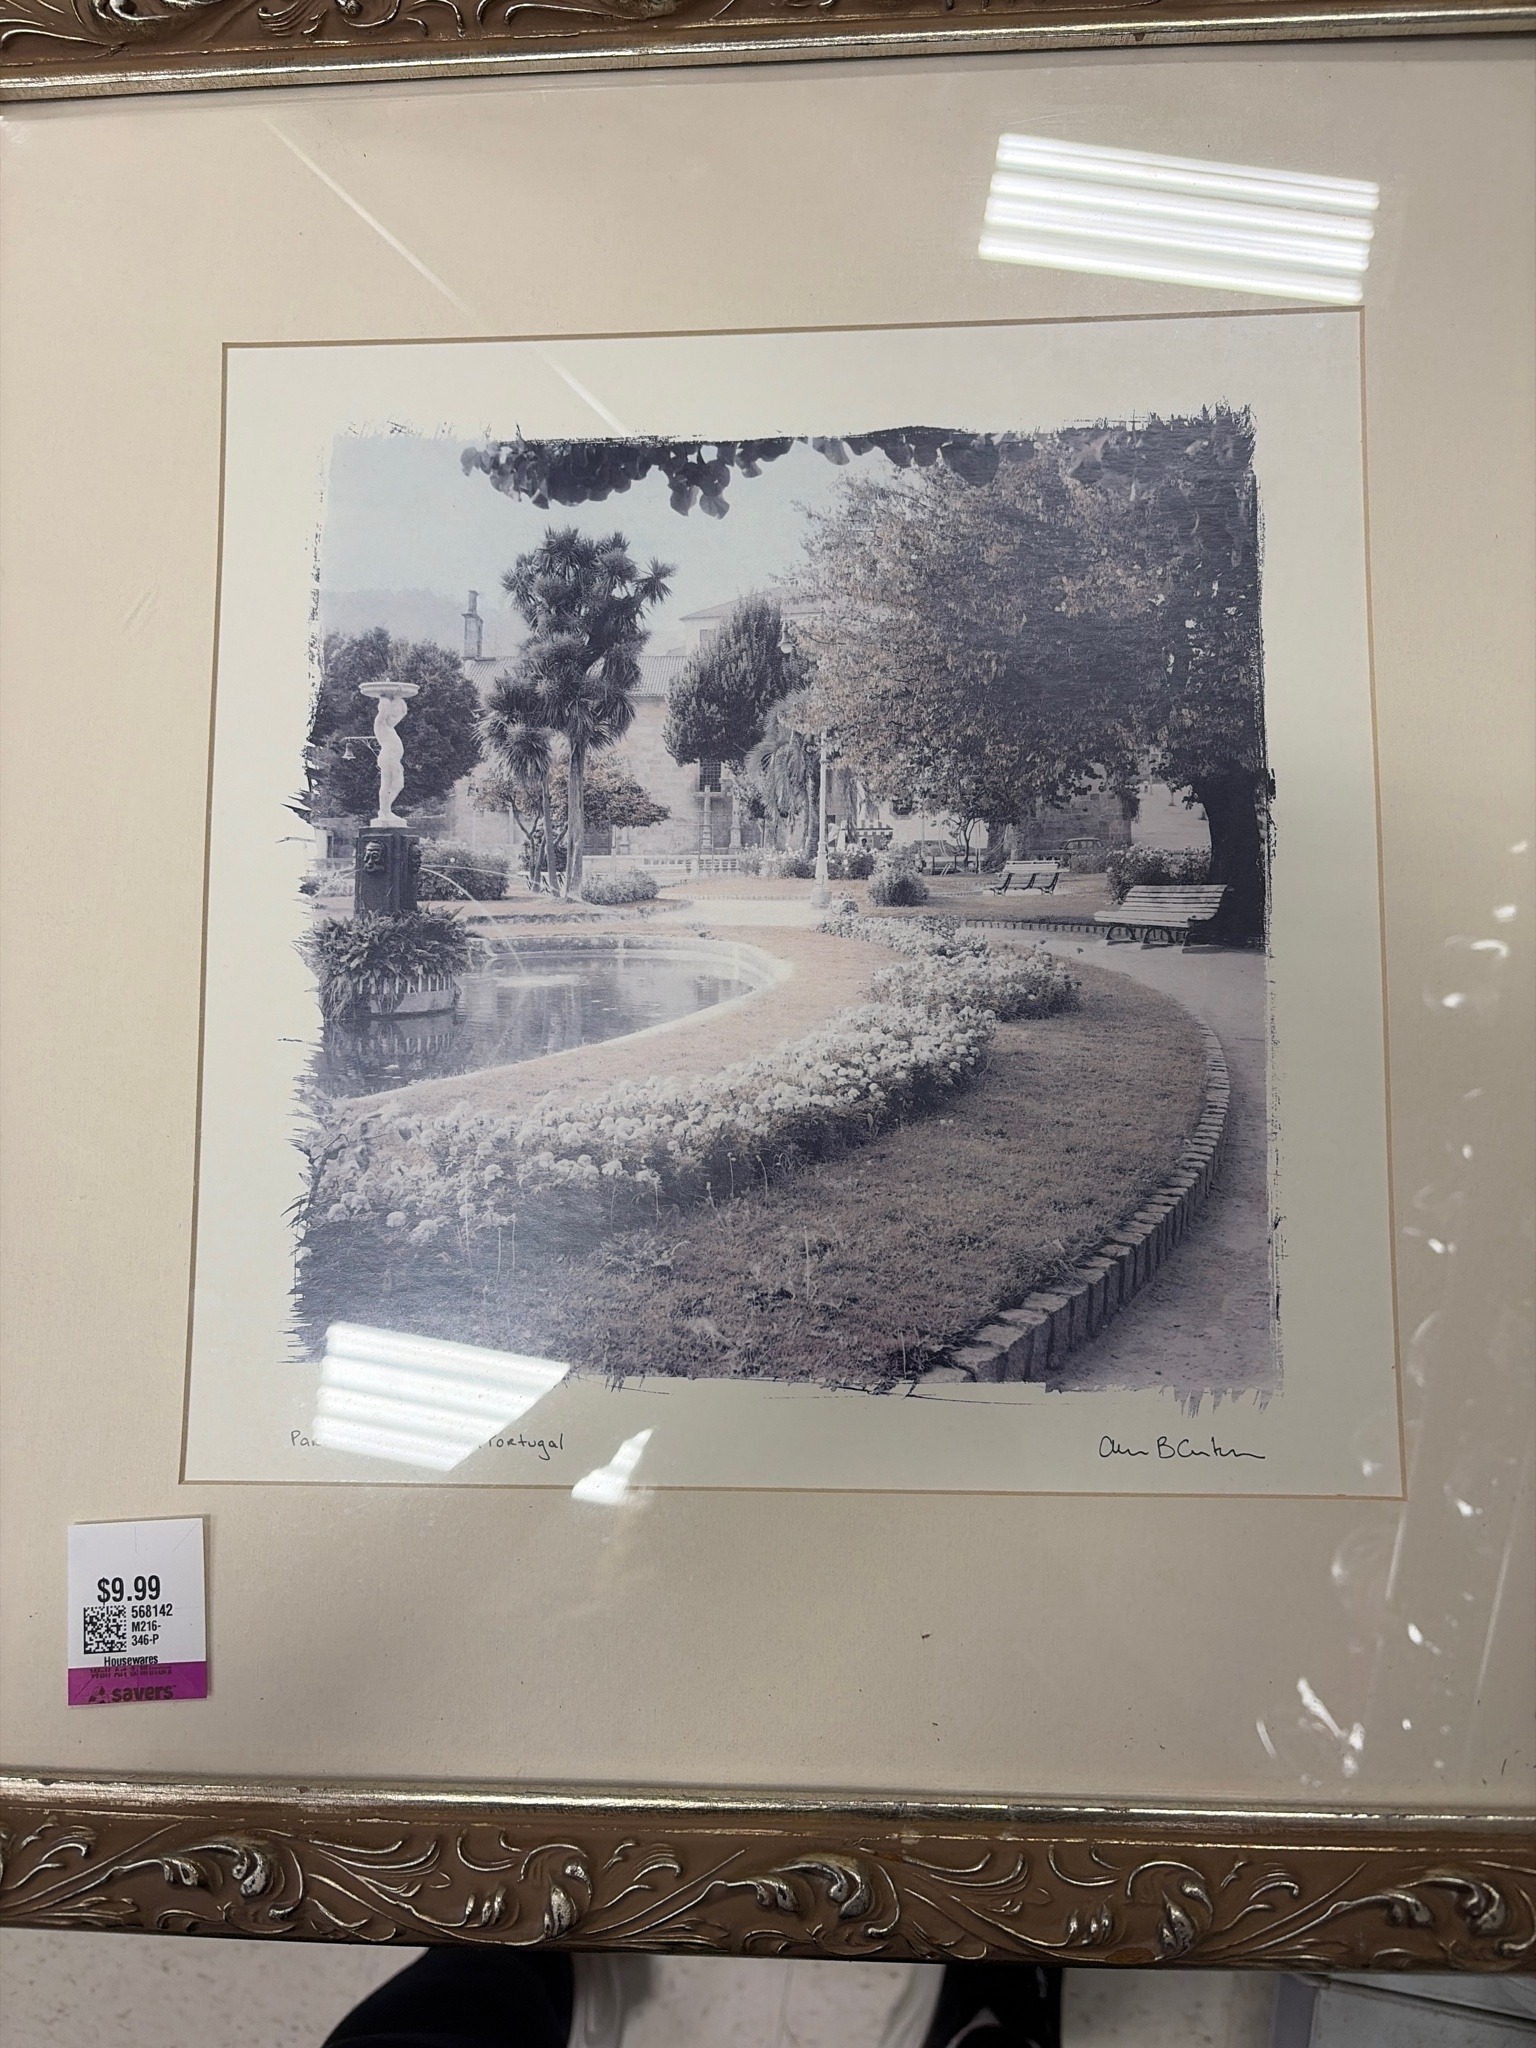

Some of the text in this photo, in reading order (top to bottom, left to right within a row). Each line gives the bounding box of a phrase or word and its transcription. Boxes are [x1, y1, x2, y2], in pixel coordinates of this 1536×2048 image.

[97, 1574, 161, 1605] $9.99
[131, 1603, 173, 1619] 568142
[131, 1619, 162, 1633] M216-
[131, 1633, 160, 1647] 346-P
[104, 1655, 159, 1667] Housewares
[111, 1684, 174, 1702] savers
